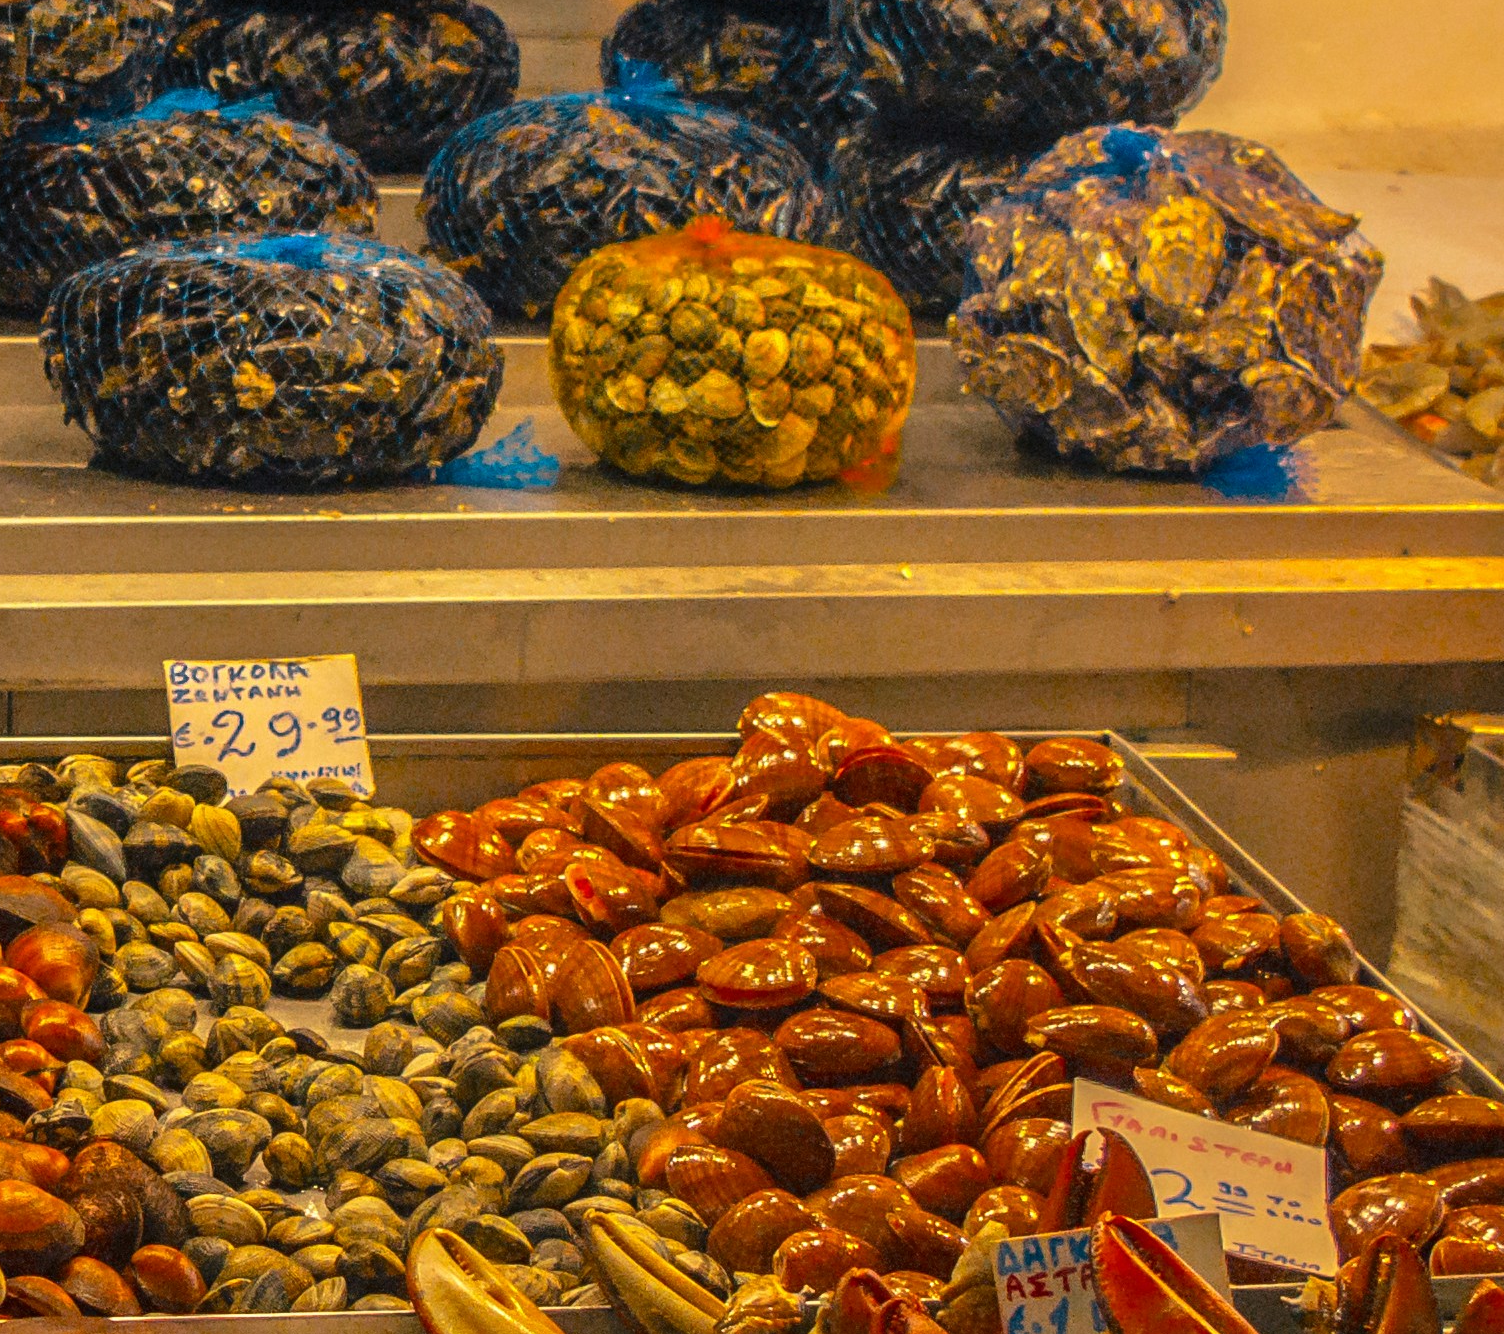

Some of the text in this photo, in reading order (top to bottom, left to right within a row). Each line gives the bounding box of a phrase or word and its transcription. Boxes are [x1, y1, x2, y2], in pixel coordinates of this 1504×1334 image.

[170, 661, 310, 686] ΒΟΓΚΟΛΑ
[1092, 1100, 1293, 1175] ΓΥΑΛΙΣΤΕΡΗ
[1006, 1263, 1093, 1302] ΑΣΤΑ
